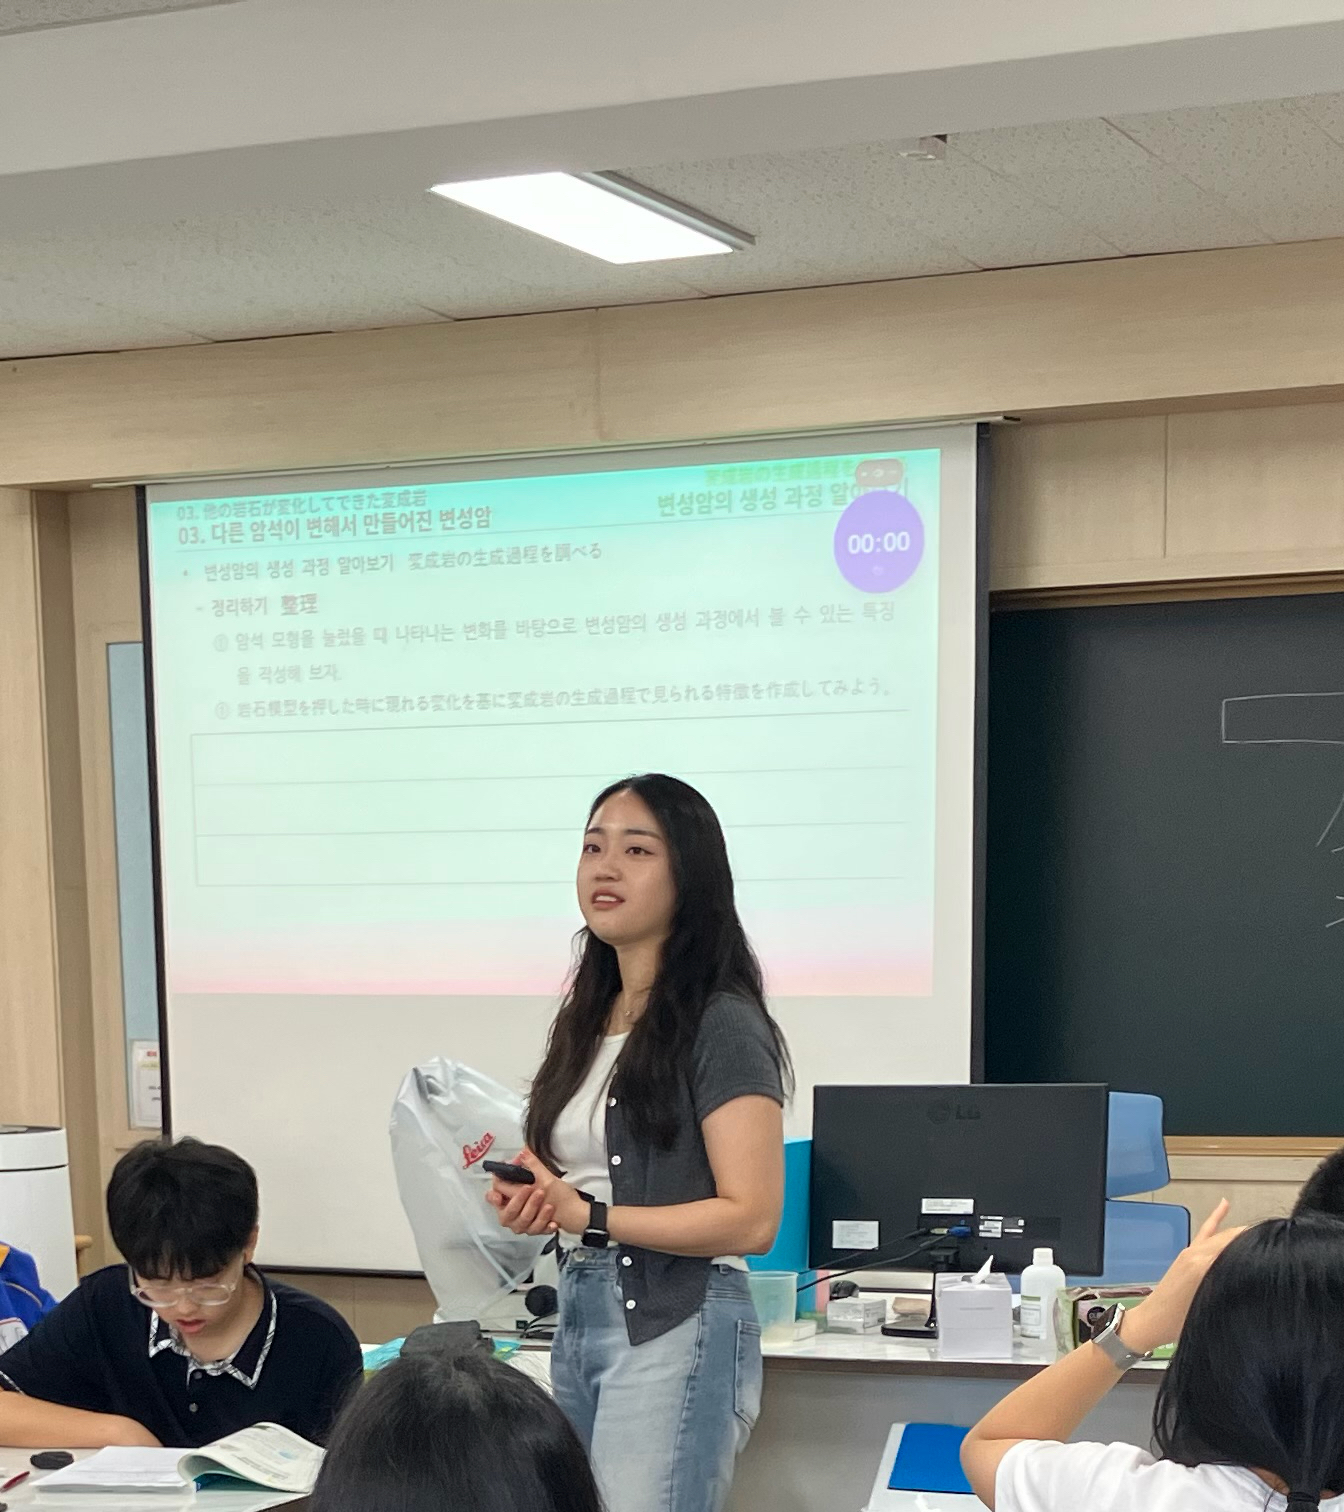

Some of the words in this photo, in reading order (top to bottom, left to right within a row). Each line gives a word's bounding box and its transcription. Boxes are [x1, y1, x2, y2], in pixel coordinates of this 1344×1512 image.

[176, 505, 199, 521] 03.
[658, 489, 734, 517] 변성암의
[739, 486, 778, 512] 생성
[784, 484, 824, 509] 과정
[179, 527, 206, 546] 03.
[212, 521, 246, 545] 다른
[251, 517, 301, 542] 암석이
[306, 512, 358, 540] 변해서
[364, 508, 433, 536] 만들어진
[439, 505, 493, 531] 변성암
[847, 530, 911, 556] 00:00
[204, 561, 260, 582] 변성암의
[267, 559, 295, 580] 생성
[302, 558, 330, 577] 과정
[337, 552, 394, 575] 알아보기
[211, 597, 268, 617] 정리하기
[280, 592, 319, 616] 整理
[235, 632, 264, 652] 암석
[271, 630, 315, 649] 모형을
[396, 622, 456, 644] 나타나는
[463, 619, 508, 641] 변화를
[515, 615, 578, 640] 바탕으로
[585, 614, 647, 636] 변성암의
[656, 611, 687, 632] 생성
[696, 607, 760, 631] 과정에서
[794, 606, 811, 625] 수
[820, 603, 854, 625] 있는
[862, 602, 895, 623] 특징
